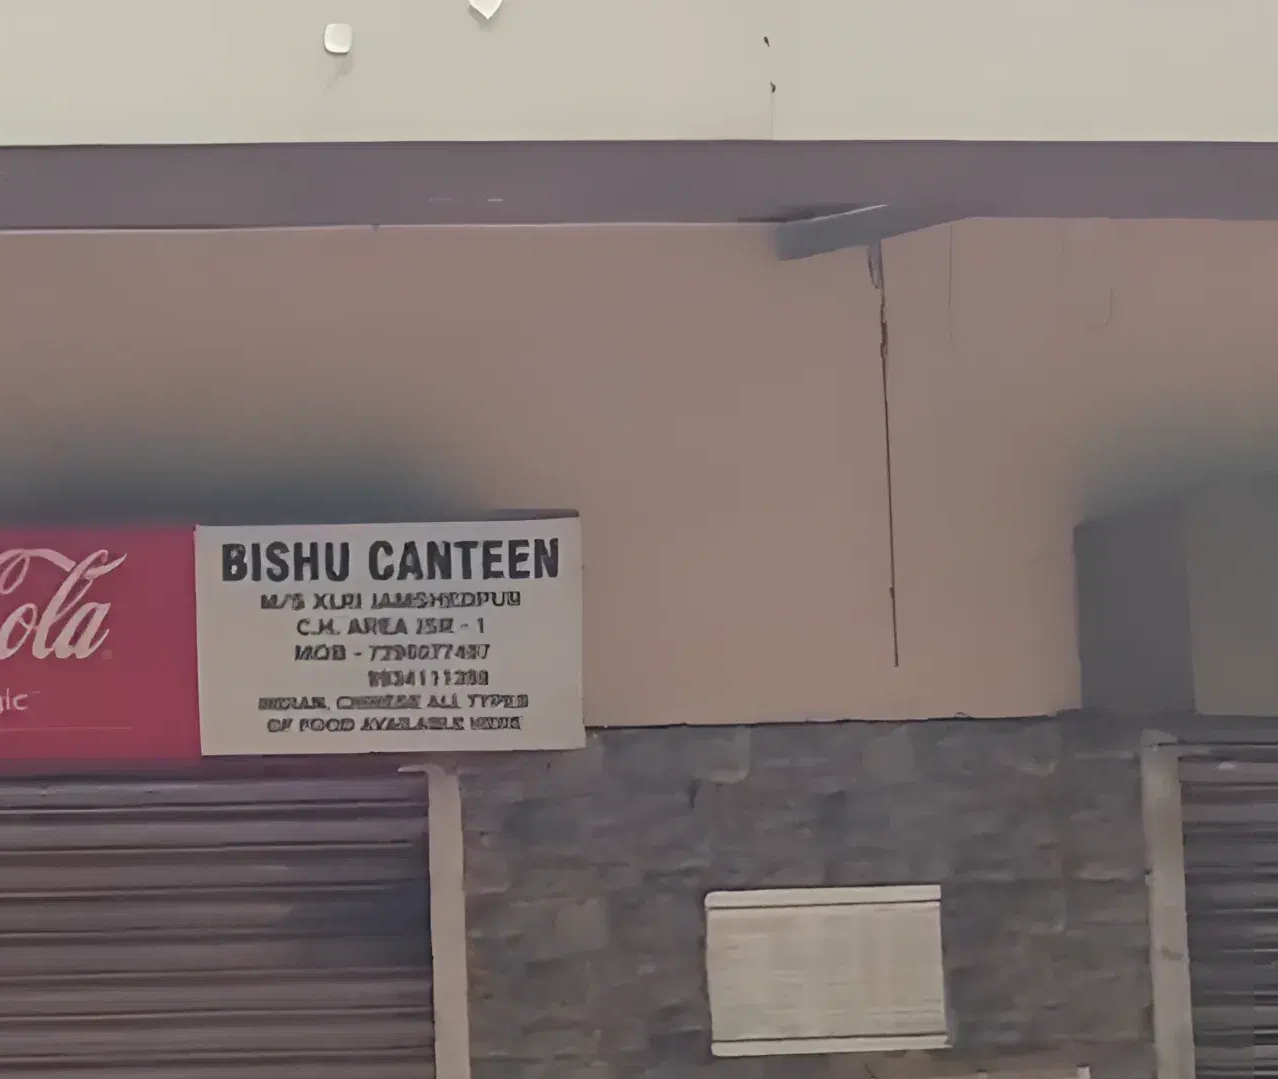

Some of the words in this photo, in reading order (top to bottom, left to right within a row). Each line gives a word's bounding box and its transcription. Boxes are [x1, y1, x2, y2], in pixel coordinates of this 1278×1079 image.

[221, 541, 350, 582] BISHU
[368, 537, 559, 581] CANTEEN
[347, 617, 408, 636] AREA
[294, 643, 347, 661] MOB
